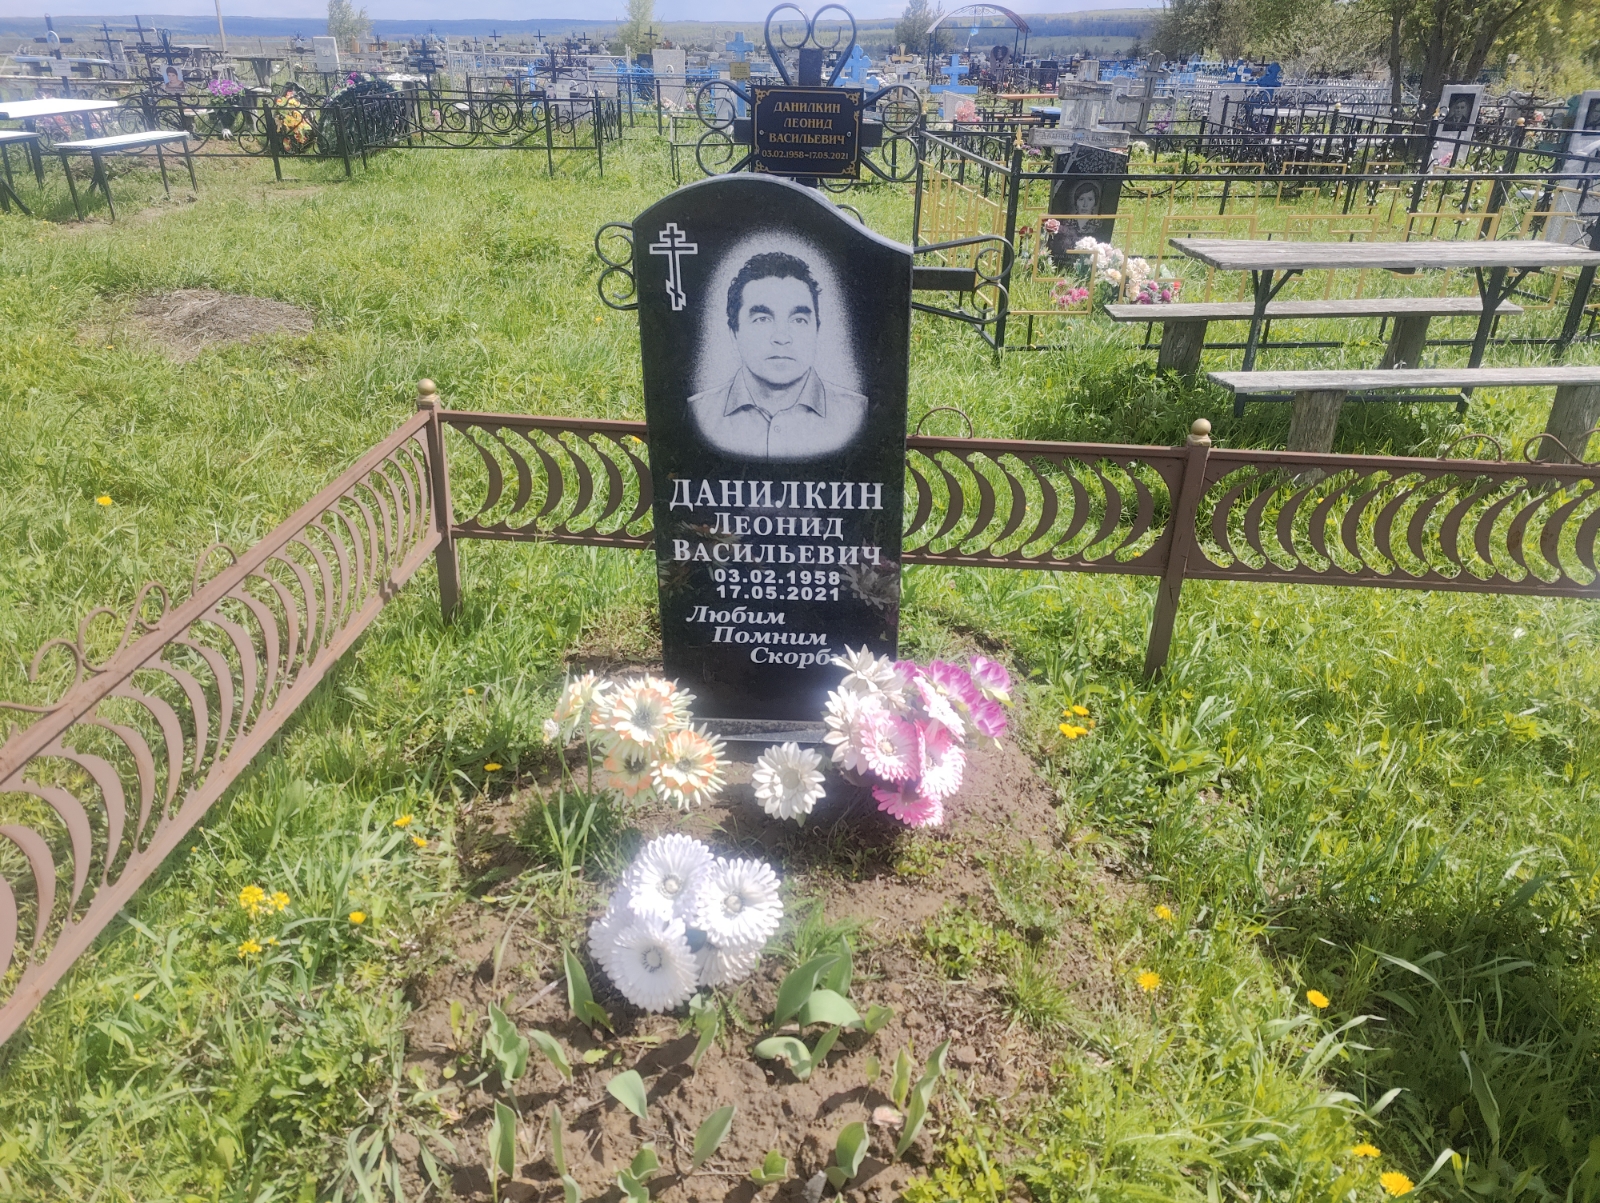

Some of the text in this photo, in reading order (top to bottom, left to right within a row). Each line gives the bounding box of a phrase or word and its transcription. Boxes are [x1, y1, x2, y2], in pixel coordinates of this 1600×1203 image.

[774, 102, 840, 113] ДАНИЛКИН
[784, 118, 832, 130] ЛЕОНИД
[769, 133, 845, 144] ВАСИЛЬЕВИЧ
[669, 479, 884, 512] ДАНИЛКИН
[709, 512, 844, 541] ЛЕОНИД
[672, 539, 882, 566] ВАСИЛЬЕВИЧ
[714, 568, 841, 585] 03.02.1958
[716, 585, 839, 601] 17.05.2021
[685, 605, 786, 625] Любим
[711, 626, 827, 645] Помним
